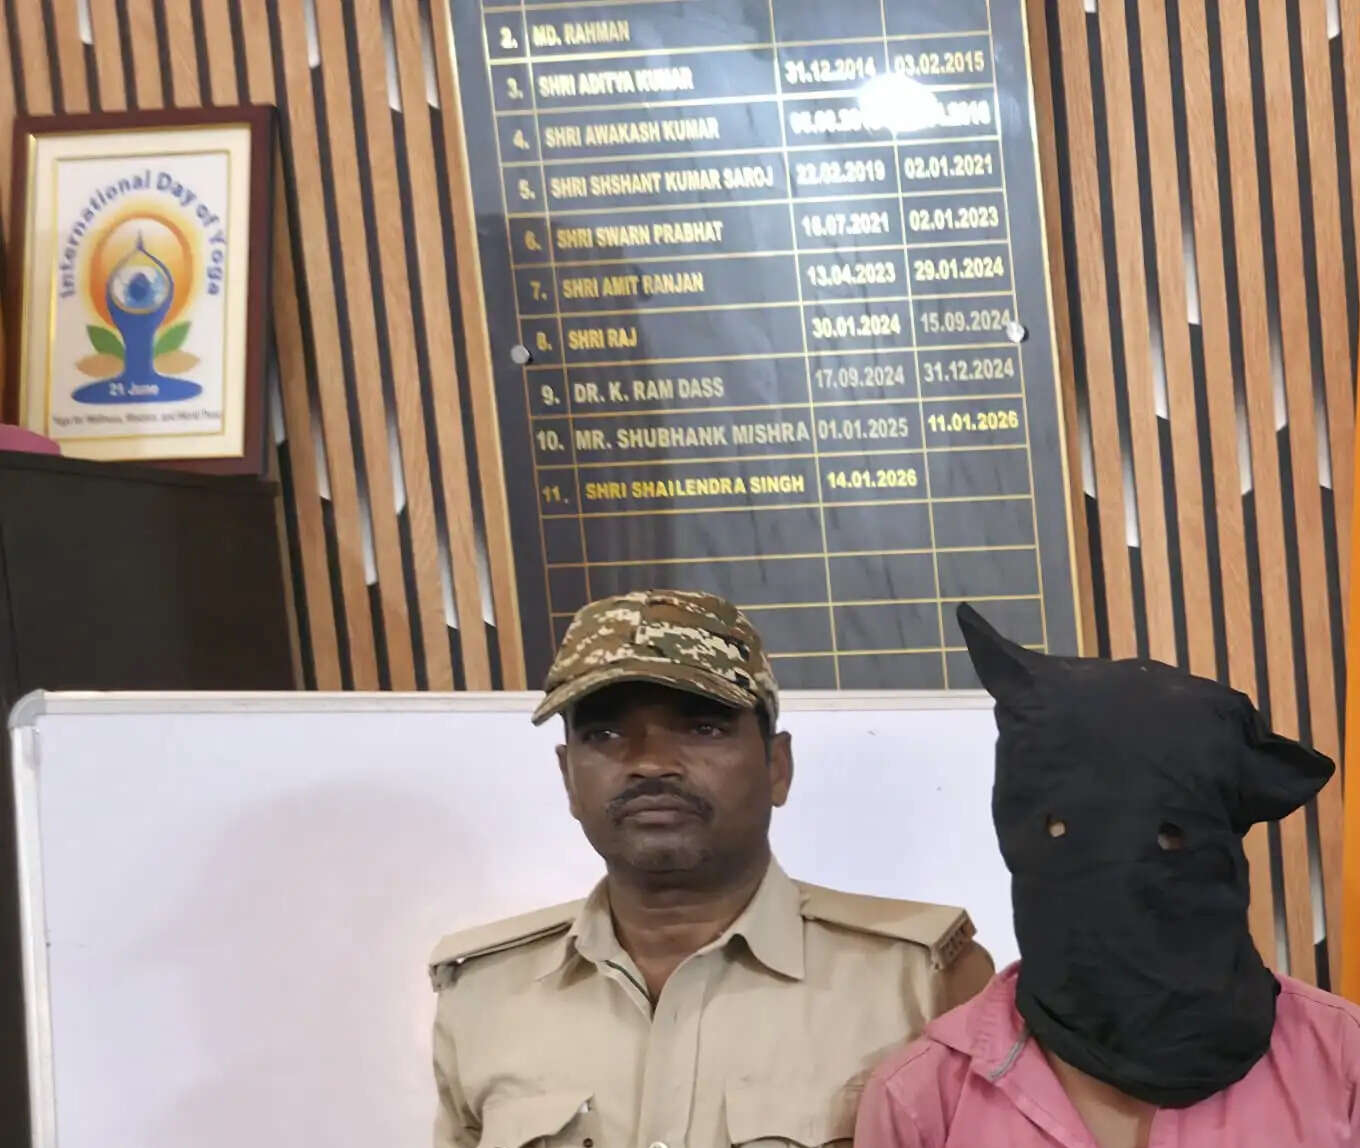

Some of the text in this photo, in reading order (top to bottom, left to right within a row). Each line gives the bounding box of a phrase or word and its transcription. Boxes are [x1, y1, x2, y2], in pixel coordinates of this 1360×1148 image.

[532, 25, 561, 47] MD.
[563, 21, 630, 44] RAHMAN
[538, 75, 576, 97] SHRI
[579, 71, 634, 96] ADITYA
[636, 66, 694, 91] KUMAR
[894, 50, 985, 75] 03.02.2015
[545, 126, 581, 148] SHRI
[585, 121, 661, 146] AWAKASH
[662, 117, 720, 141] KUMAR
[551, 176, 588, 198] SHRI
[665, 169, 722, 192] KUMAR
[723, 165, 774, 188] SAROJ
[904, 153, 993, 179] 02.01.2021
[60, 169, 227, 298] International Day of Yoga
[557, 228, 593, 249] SHRI
[596, 225, 651, 247] SWARN
[653, 221, 723, 244] PRABHAT
[909, 206, 999, 232] 02.01.2023
[530, 256, 1004, 300] 7. SHRI AMIT RANJAN 13.04.2023 29.01.2024
[568, 329, 604, 350] SHRI
[606, 327, 637, 348] RAJ
[812, 313, 901, 338] 30.01.2024
[920, 309, 1011, 333] 15.09.2024
[108, 382, 160, 397] 21 June
[541, 358, 1015, 405] 9. DR. K. RAM DASS 17.09.2024 31.12.2024
[537, 410, 1020, 451] 10. MR. SHUBHANK MISHRA 01.01.2025 11.01.2026
[586, 482, 627, 501] SHRI
[632, 477, 746, 499] SHAILENDRA
[749, 474, 805, 494] SINGH
[827, 469, 918, 489] 14.01.2026
